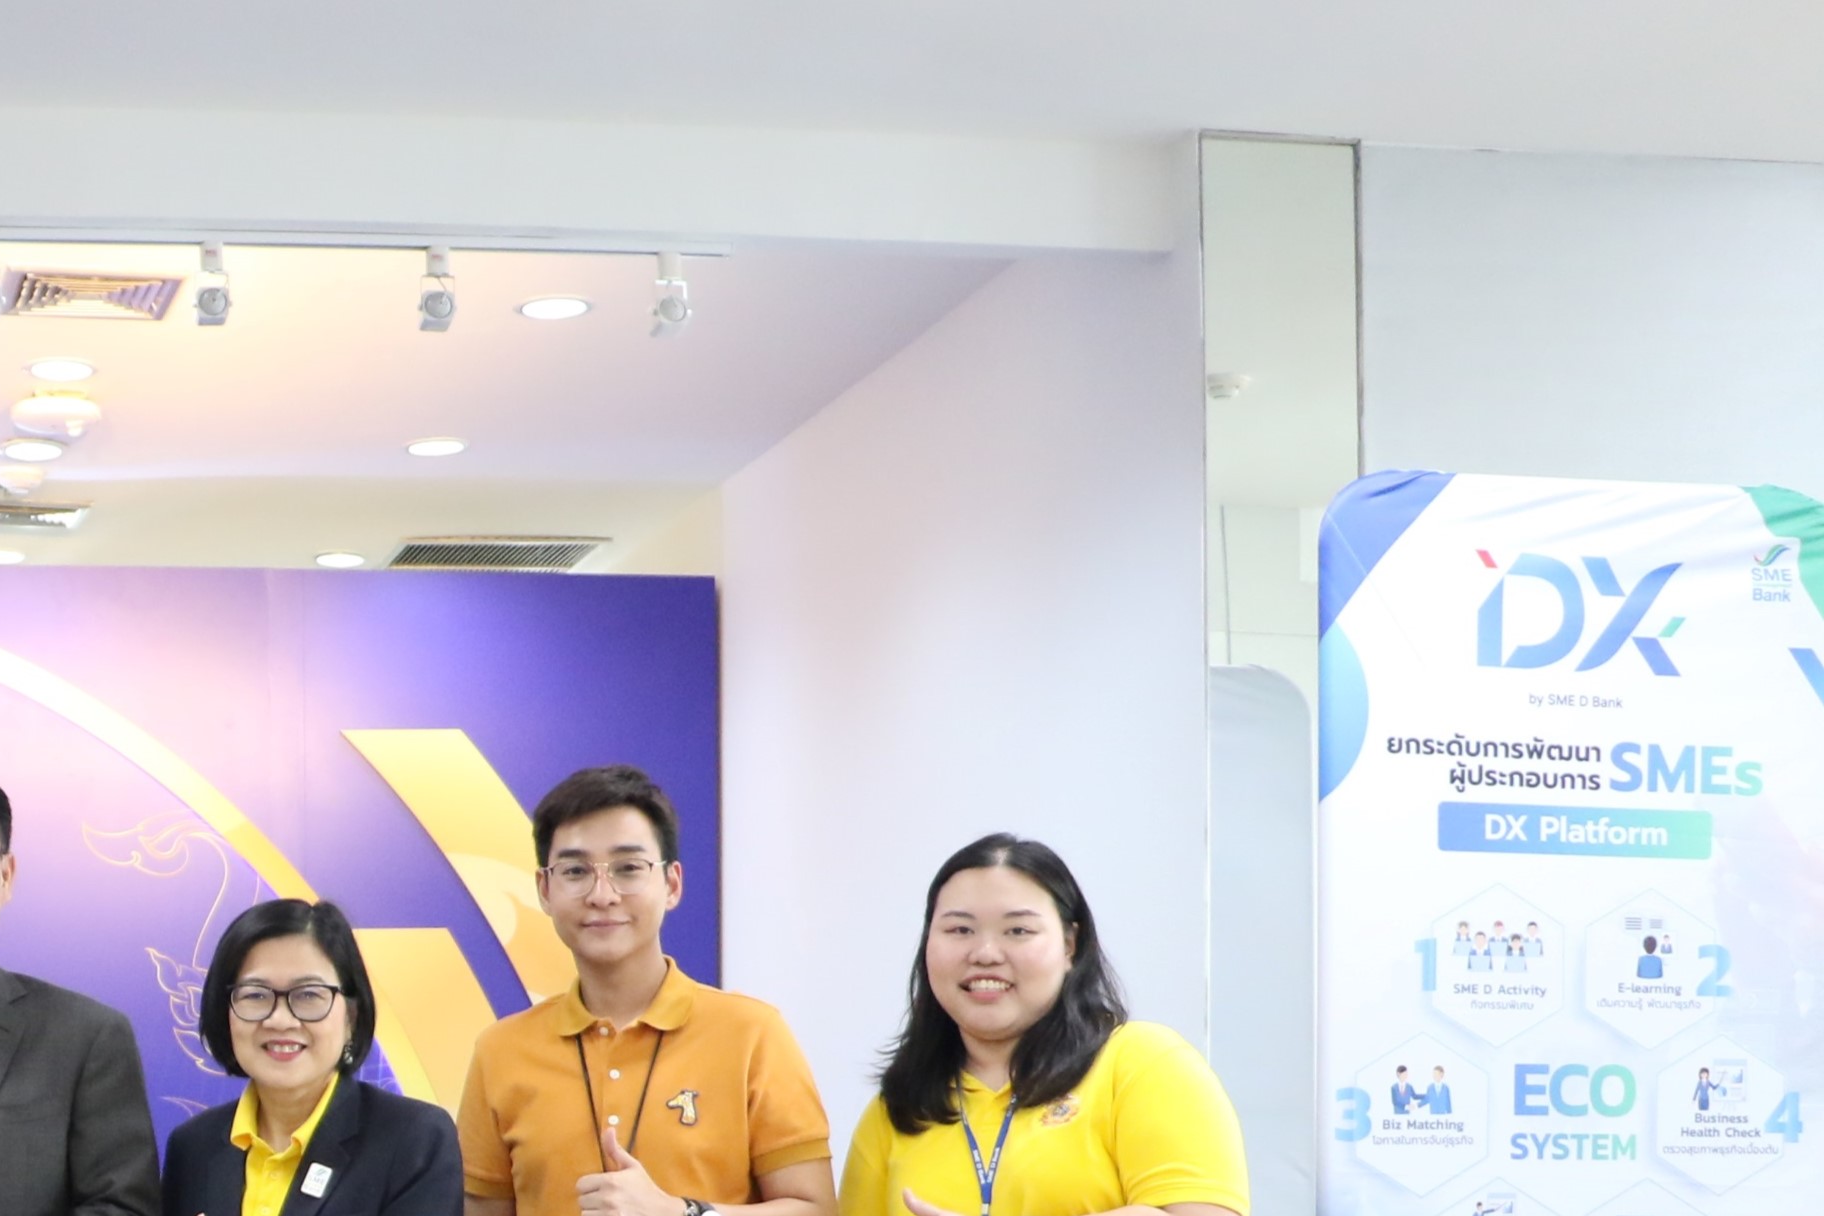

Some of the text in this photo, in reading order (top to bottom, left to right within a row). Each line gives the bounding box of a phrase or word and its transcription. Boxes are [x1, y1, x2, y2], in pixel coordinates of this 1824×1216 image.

[1751, 567, 1792, 582] SME
[1752, 588, 1791, 602] Bank
[1529, 692, 1624, 708] by SME D Bank
[1386, 733, 1602, 763] ยกระดับการพัฒนา
[1449, 761, 1602, 793] ผู้ประกอบการ
[1609, 742, 1764, 797] SMEs
[1484, 814, 1668, 846] DX Platform
[1414, 938, 1438, 992] 1
[1696, 944, 1734, 998] 2
[1453, 983, 1547, 998] SME D Activity
[1617, 982, 1682, 996] E-learning
[1513, 1063, 1637, 1118] ECO
[1334, 1087, 1373, 1142] 3
[1382, 1119, 1464, 1132] Biz Matching
[1694, 1112, 1749, 1123] Business
[1764, 1092, 1804, 1144] 4
[1510, 1132, 1637, 1162] SYSTEM
[1680, 1127, 1761, 1138] Health Check
